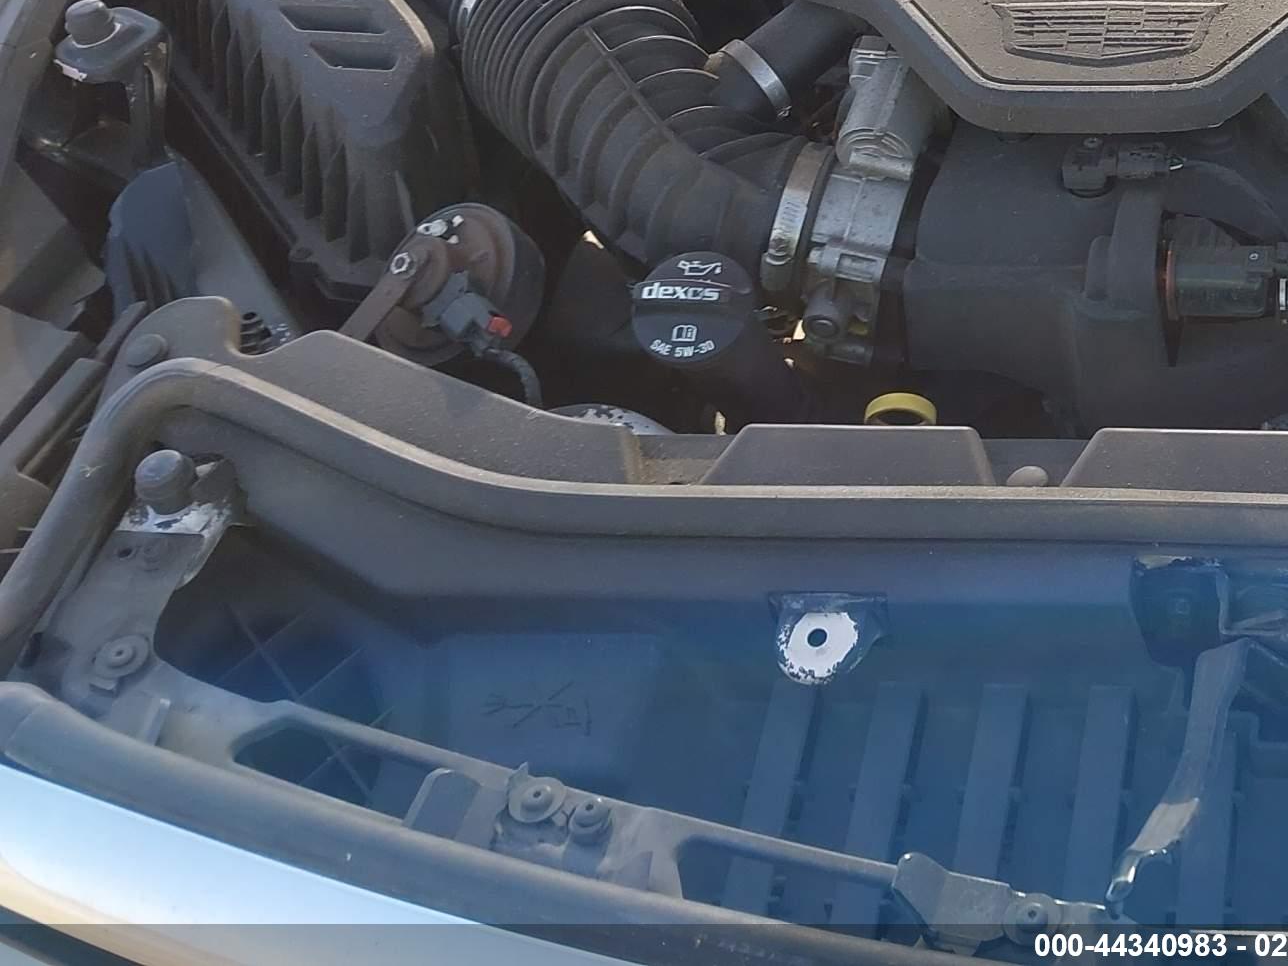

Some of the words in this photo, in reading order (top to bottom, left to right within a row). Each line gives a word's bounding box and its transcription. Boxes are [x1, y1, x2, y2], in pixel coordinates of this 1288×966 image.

[641, 282, 723, 301] dexos
[650, 339, 672, 355] SAE
[674, 340, 715, 357] 5W-30
